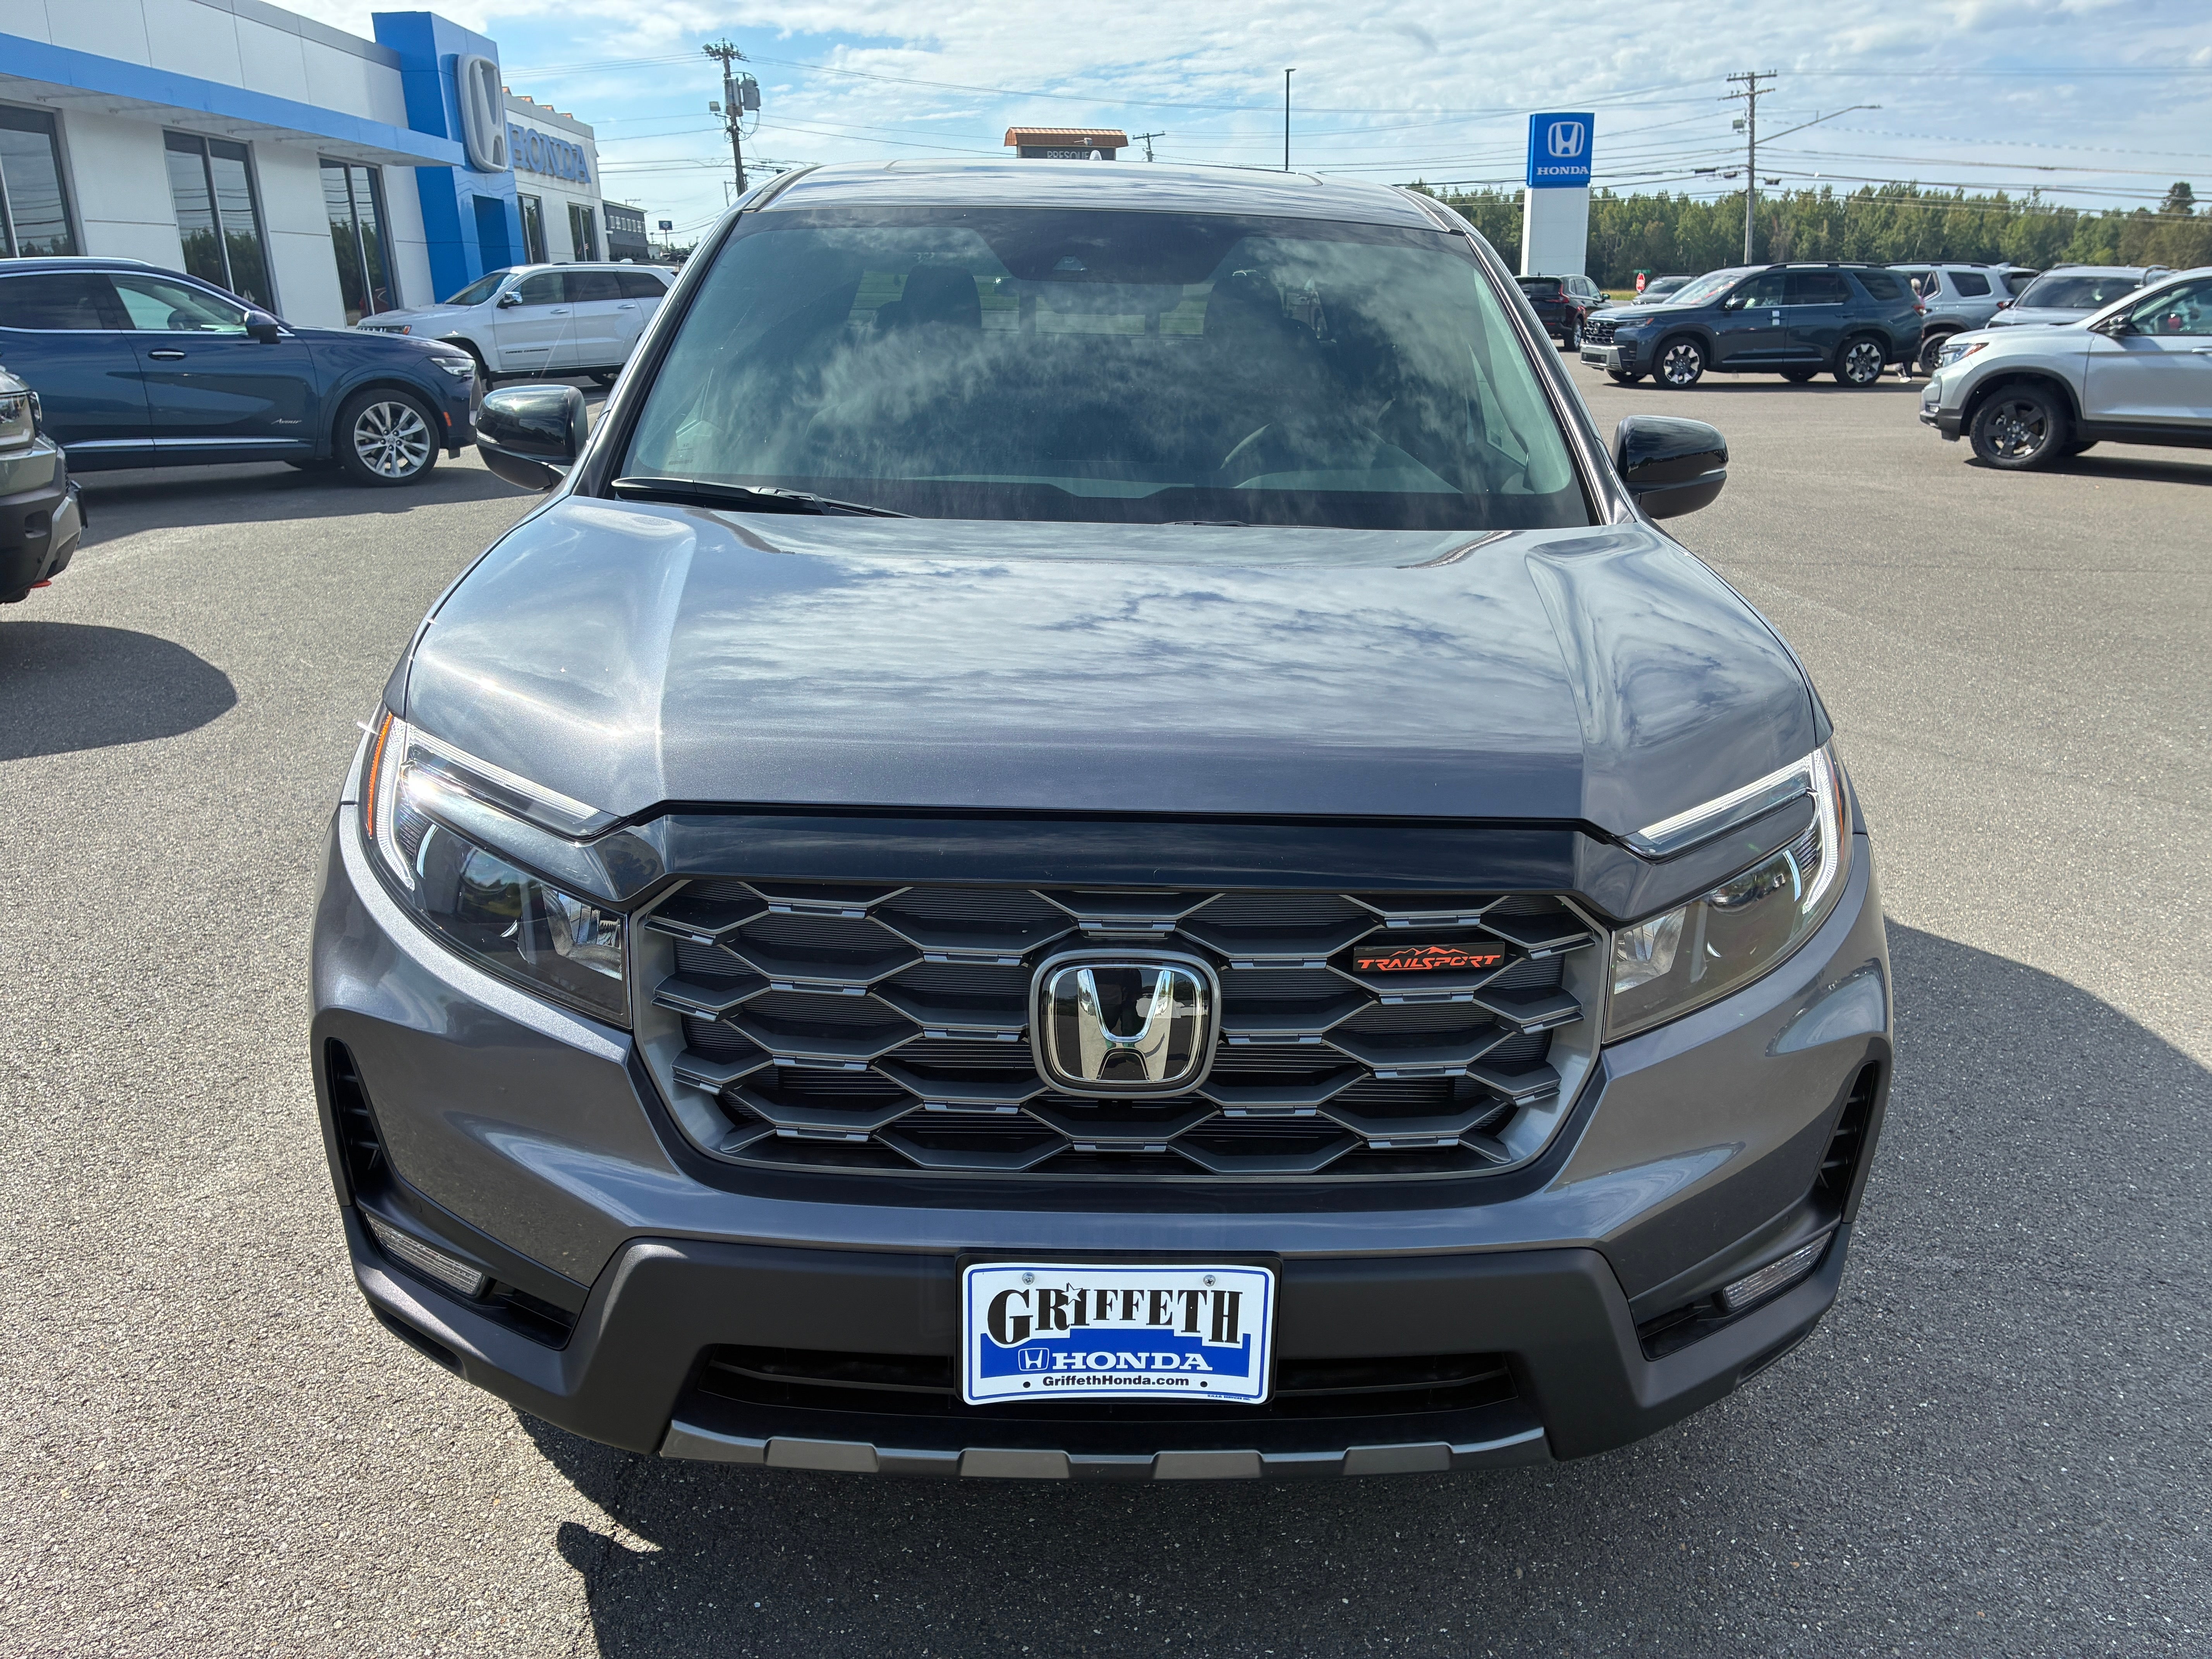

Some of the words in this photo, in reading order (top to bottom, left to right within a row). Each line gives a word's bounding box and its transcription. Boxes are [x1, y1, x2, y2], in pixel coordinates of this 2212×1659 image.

[507, 122, 592, 184] HONDA
[1537, 166, 1589, 175] HONDA
[1357, 955, 1501, 971] TRAILSPORT
[987, 1288, 1243, 1345] GRIFFETH
[1052, 1352, 1213, 1371] HONDA
[1042, 1375, 1189, 1386] GriffethHonda.com
